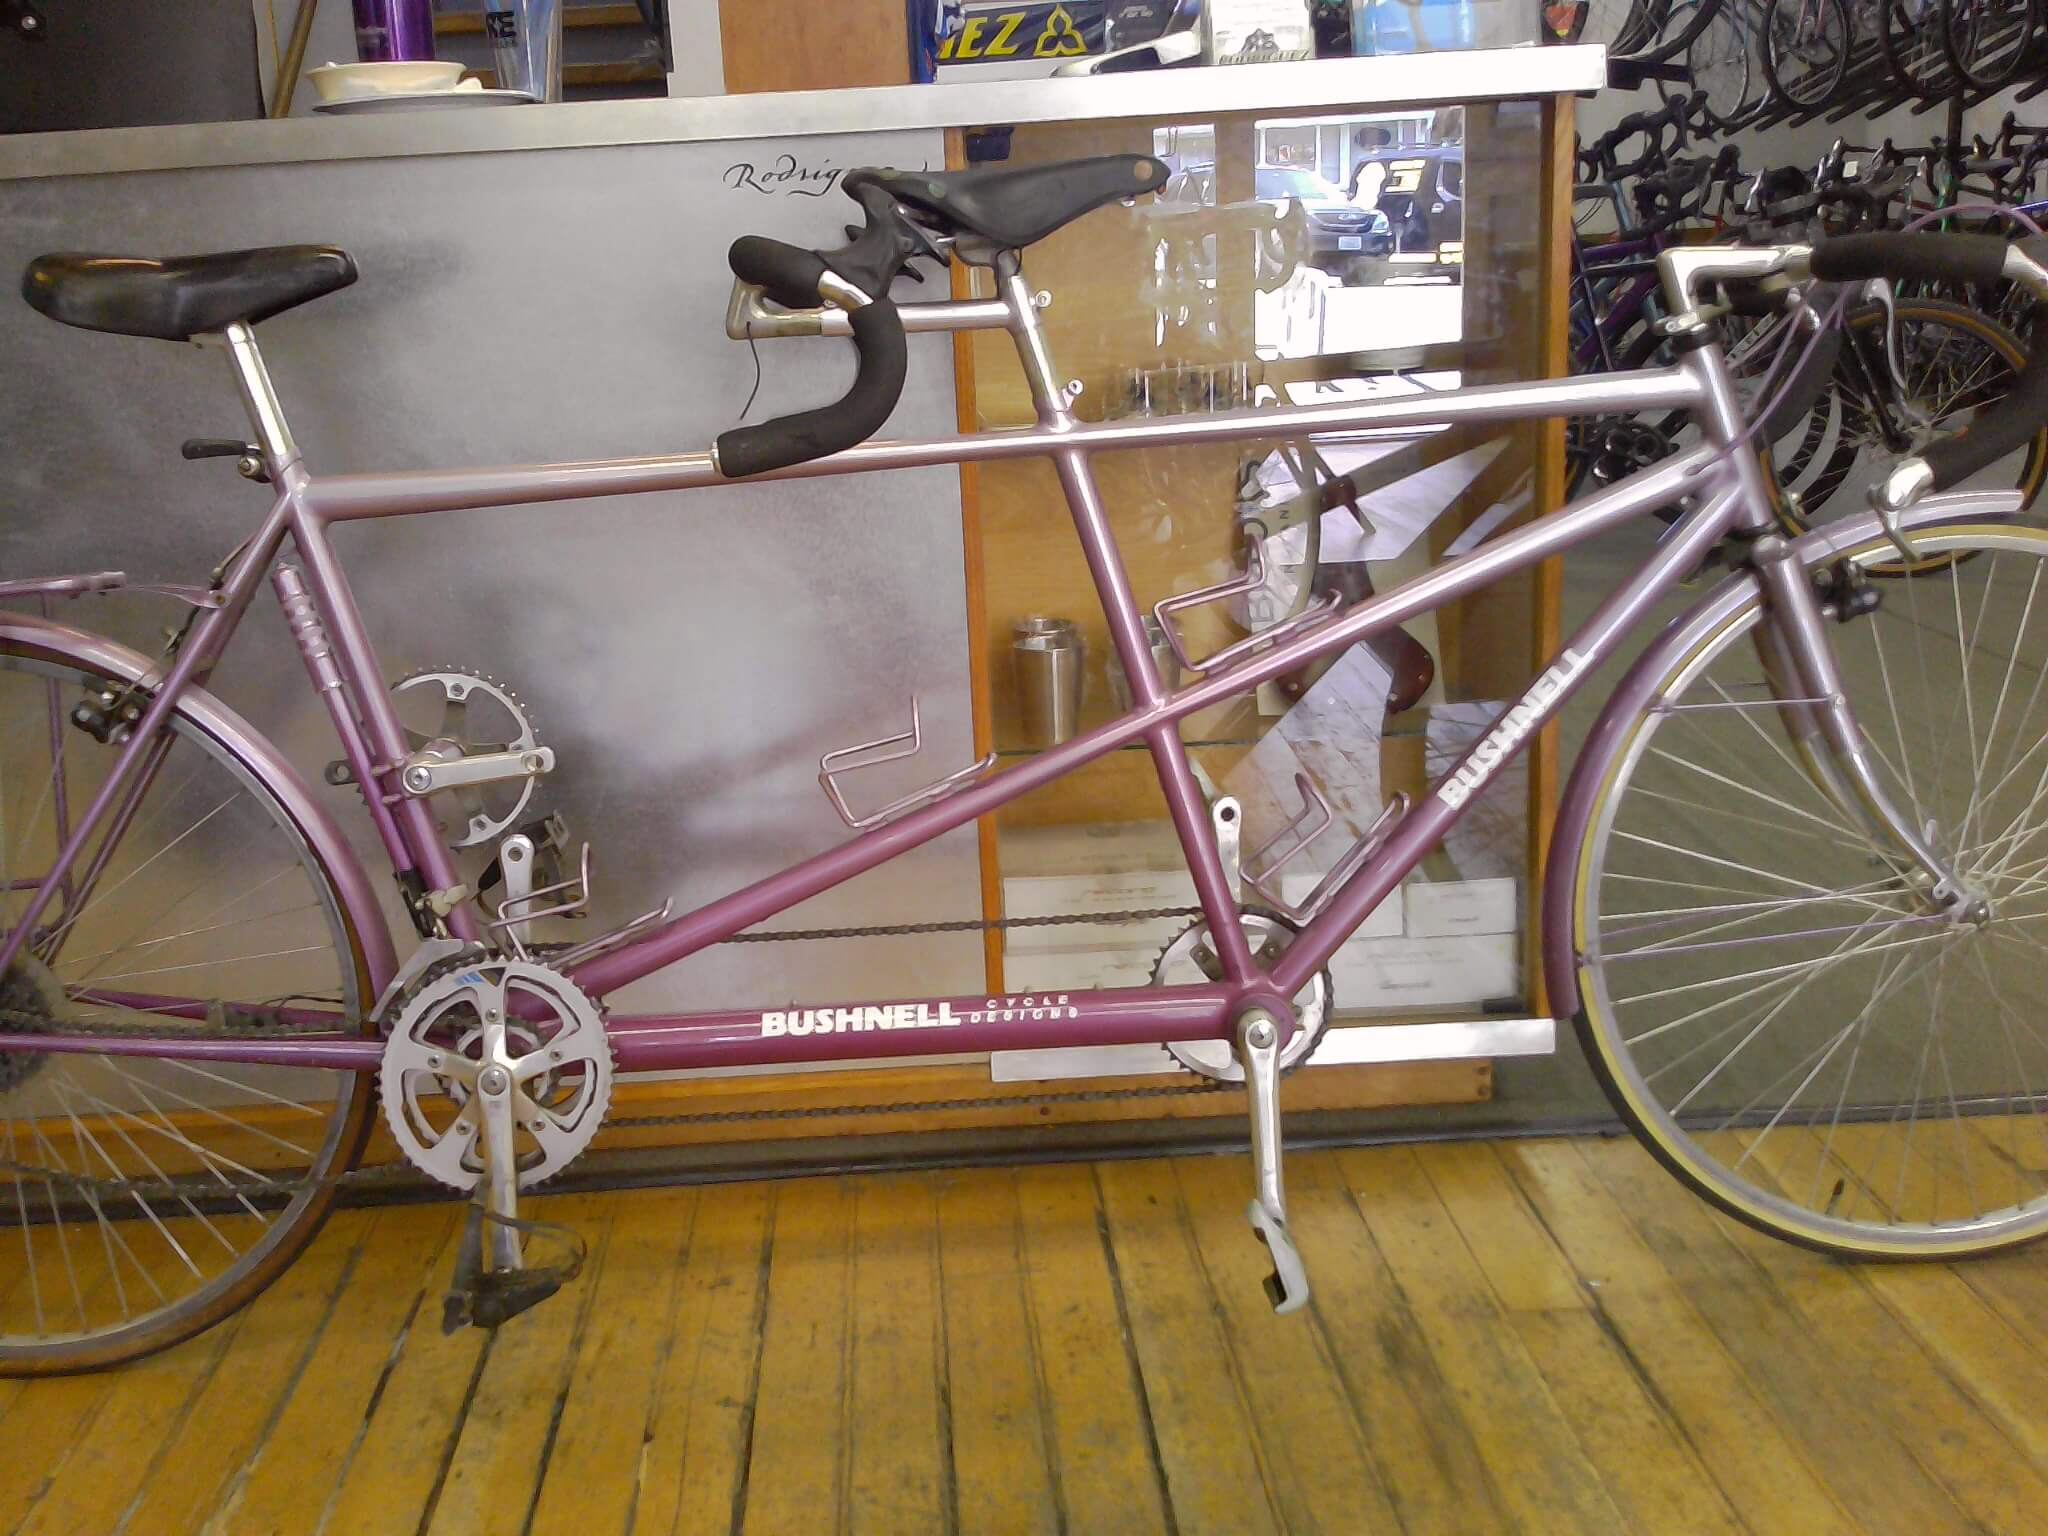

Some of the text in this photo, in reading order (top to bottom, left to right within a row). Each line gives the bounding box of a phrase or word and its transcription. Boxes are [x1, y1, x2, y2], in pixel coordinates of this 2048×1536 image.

[722, 153, 846, 197] Rodrig
[1436, 648, 1594, 811] BUSHNELL
[761, 1002, 962, 1037] BUSHNELL
[986, 995, 1069, 1009] CYCLE
